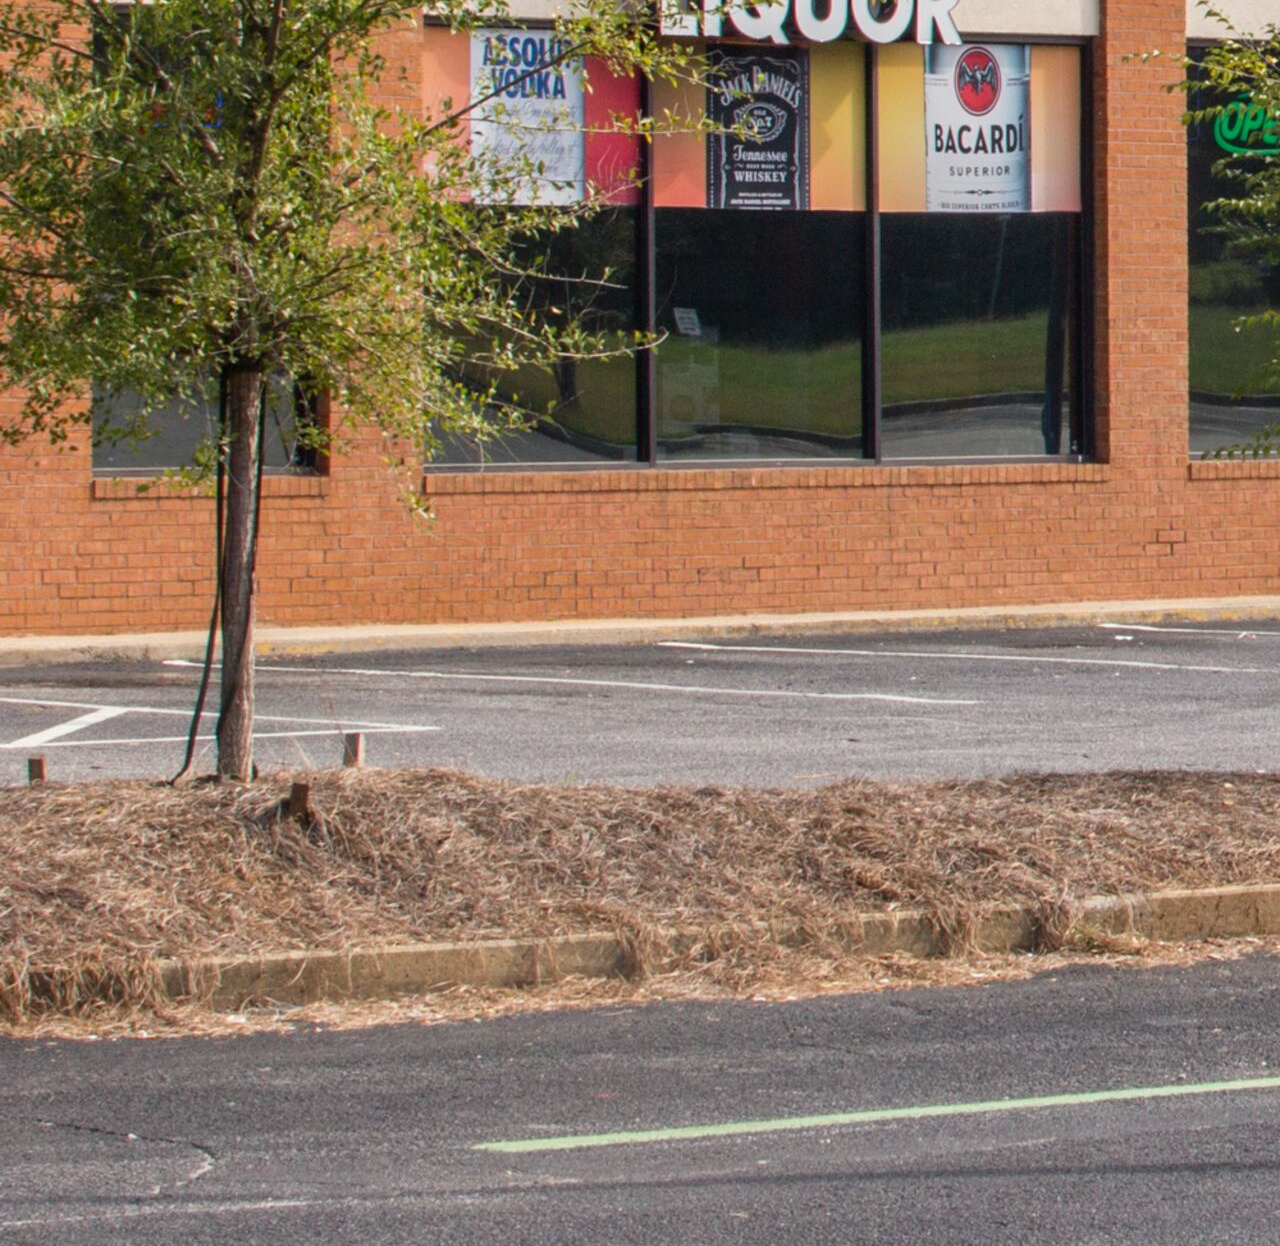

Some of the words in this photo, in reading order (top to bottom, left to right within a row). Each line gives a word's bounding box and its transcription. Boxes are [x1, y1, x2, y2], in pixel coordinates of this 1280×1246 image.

[491, 68, 566, 99] VODKA
[934, 115, 1024, 154] BACARDÍ
[733, 145, 788, 162] Tennessee
[734, 171, 788, 182] WHISKEY
[949, 165, 1011, 177] SUPERIOR
